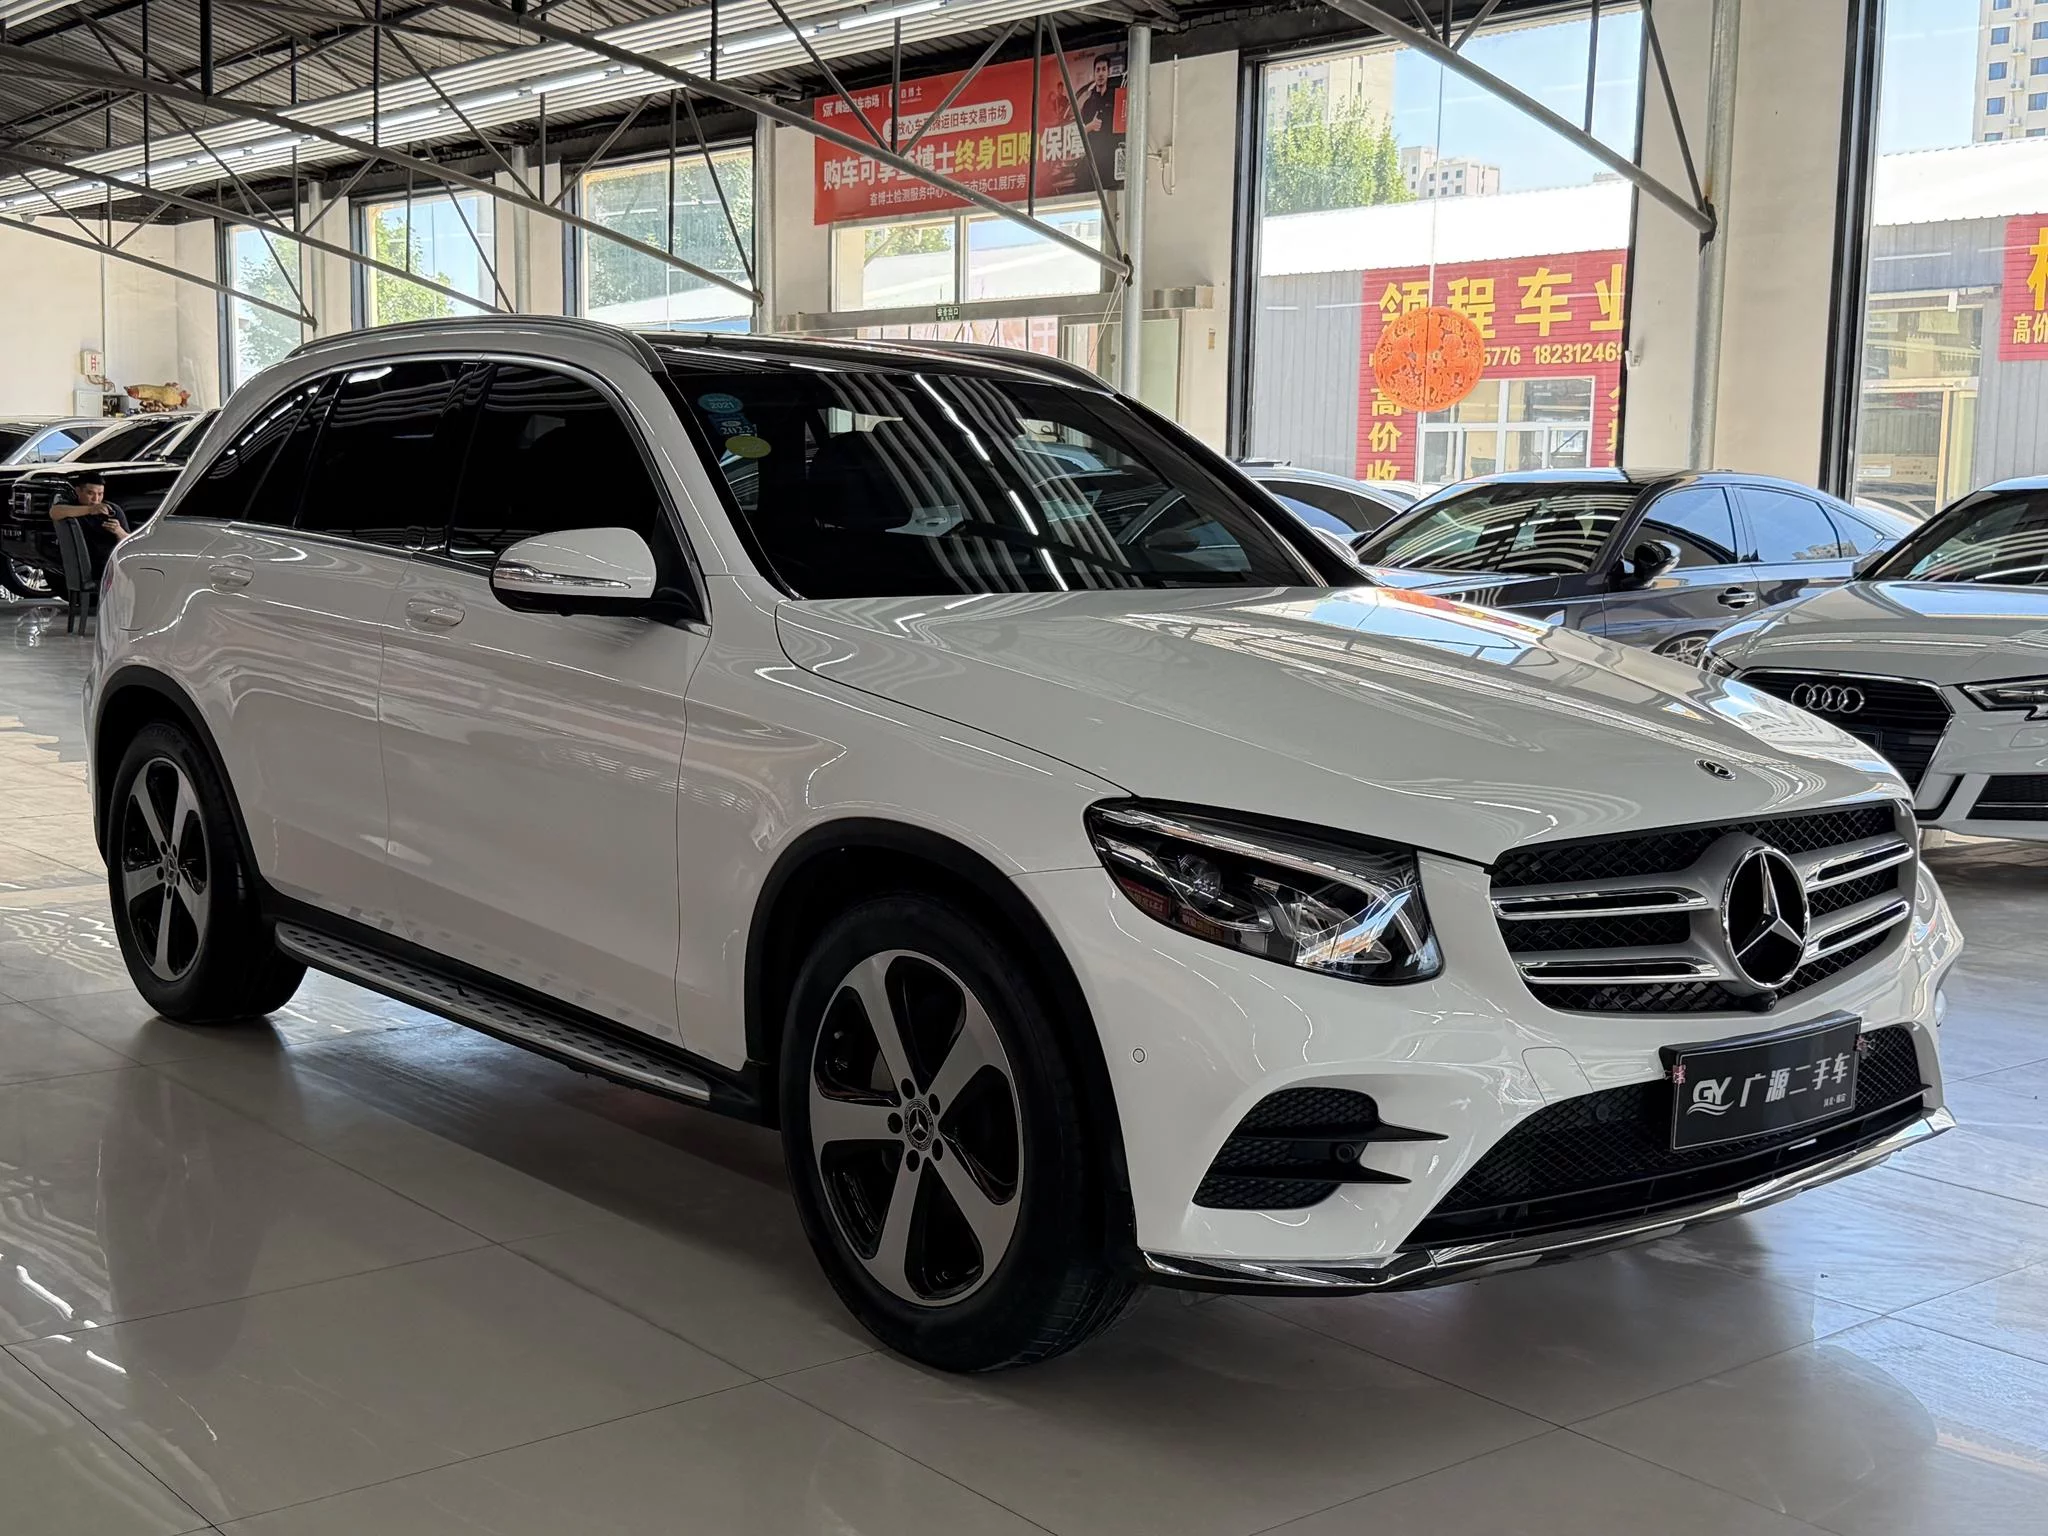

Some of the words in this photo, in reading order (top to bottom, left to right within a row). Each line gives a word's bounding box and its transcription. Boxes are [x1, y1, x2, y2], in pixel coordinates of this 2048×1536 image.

[709, 401, 735, 409] 2021
[1739, 1052, 1850, 1108] 广源二手车
